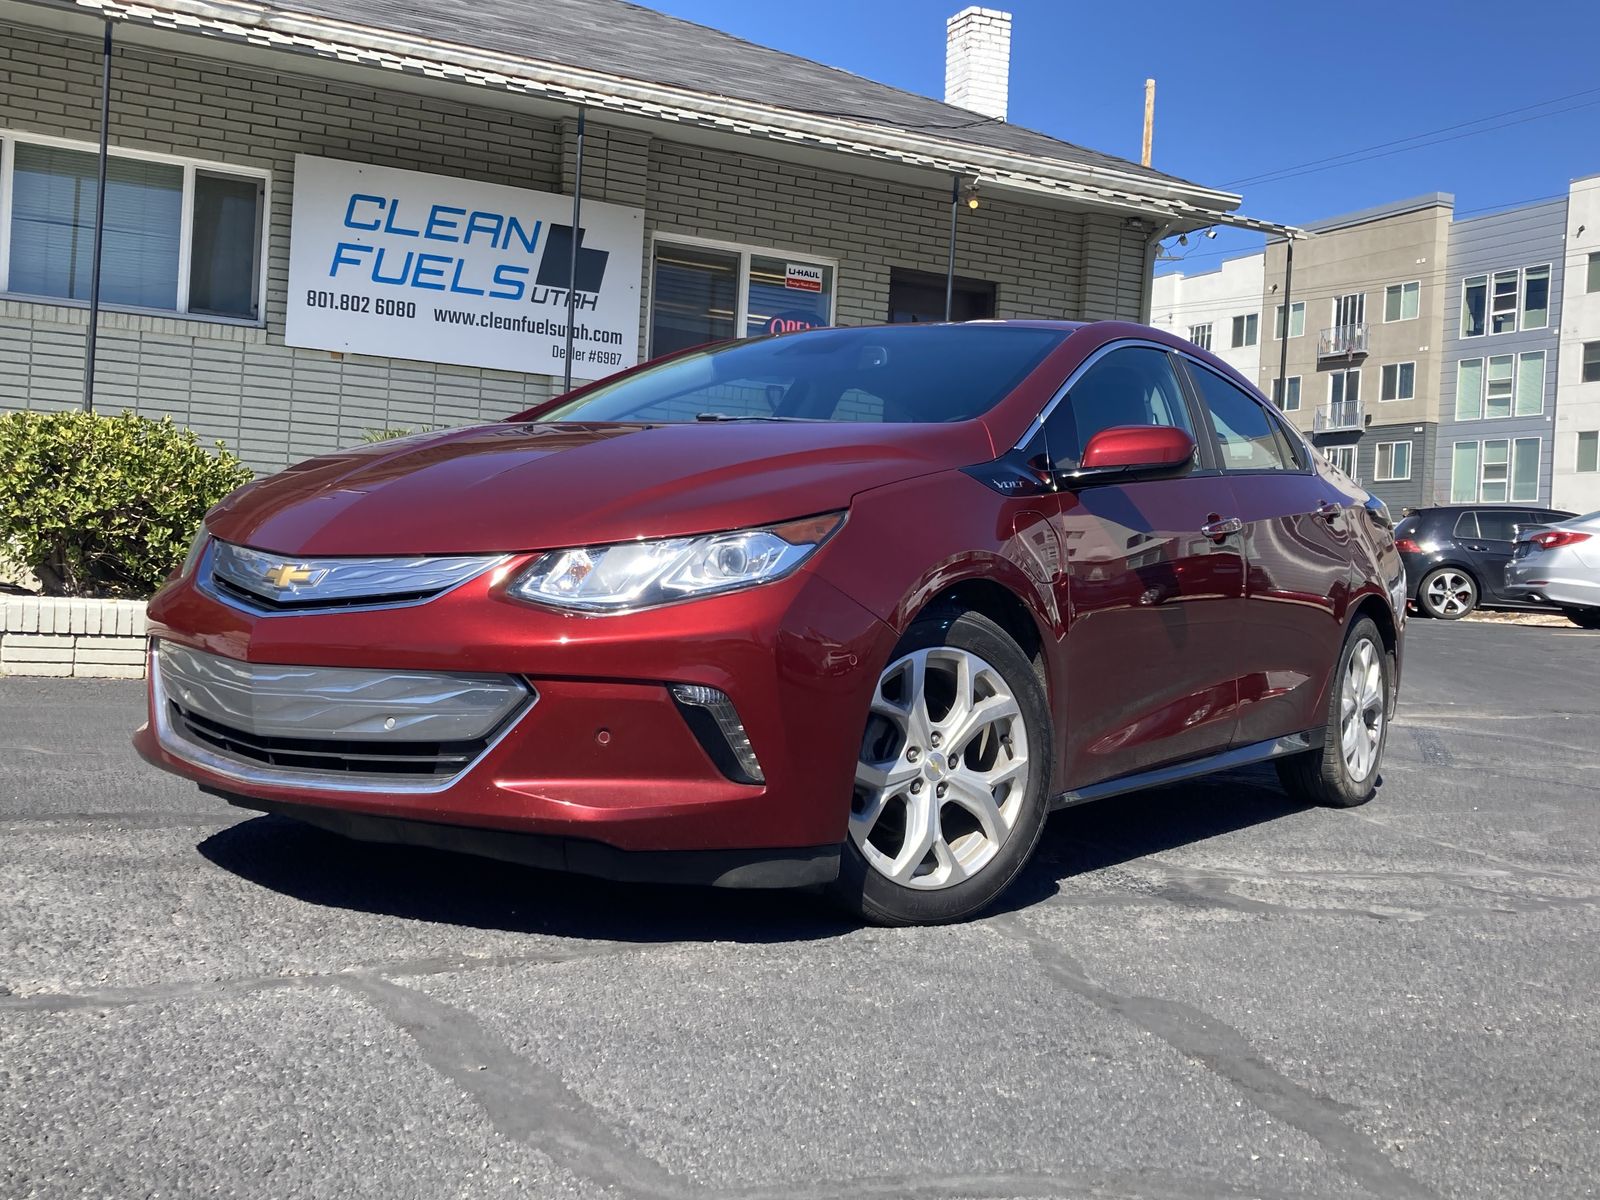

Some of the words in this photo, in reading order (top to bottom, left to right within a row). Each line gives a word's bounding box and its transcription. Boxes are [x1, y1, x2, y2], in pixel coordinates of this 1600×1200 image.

[344, 193, 542, 253] CLEAN
[329, 242, 529, 301] FUELS
[788, 268, 820, 279] U-HAUL
[306, 289, 370, 314] 801.802
[375, 298, 416, 319] 6080
[530, 286, 599, 312] UTAH
[434, 307, 623, 346] www.cleanfuelsuah.com
[552, 344, 586, 361] Deler
[588, 349, 623, 367] #6987
